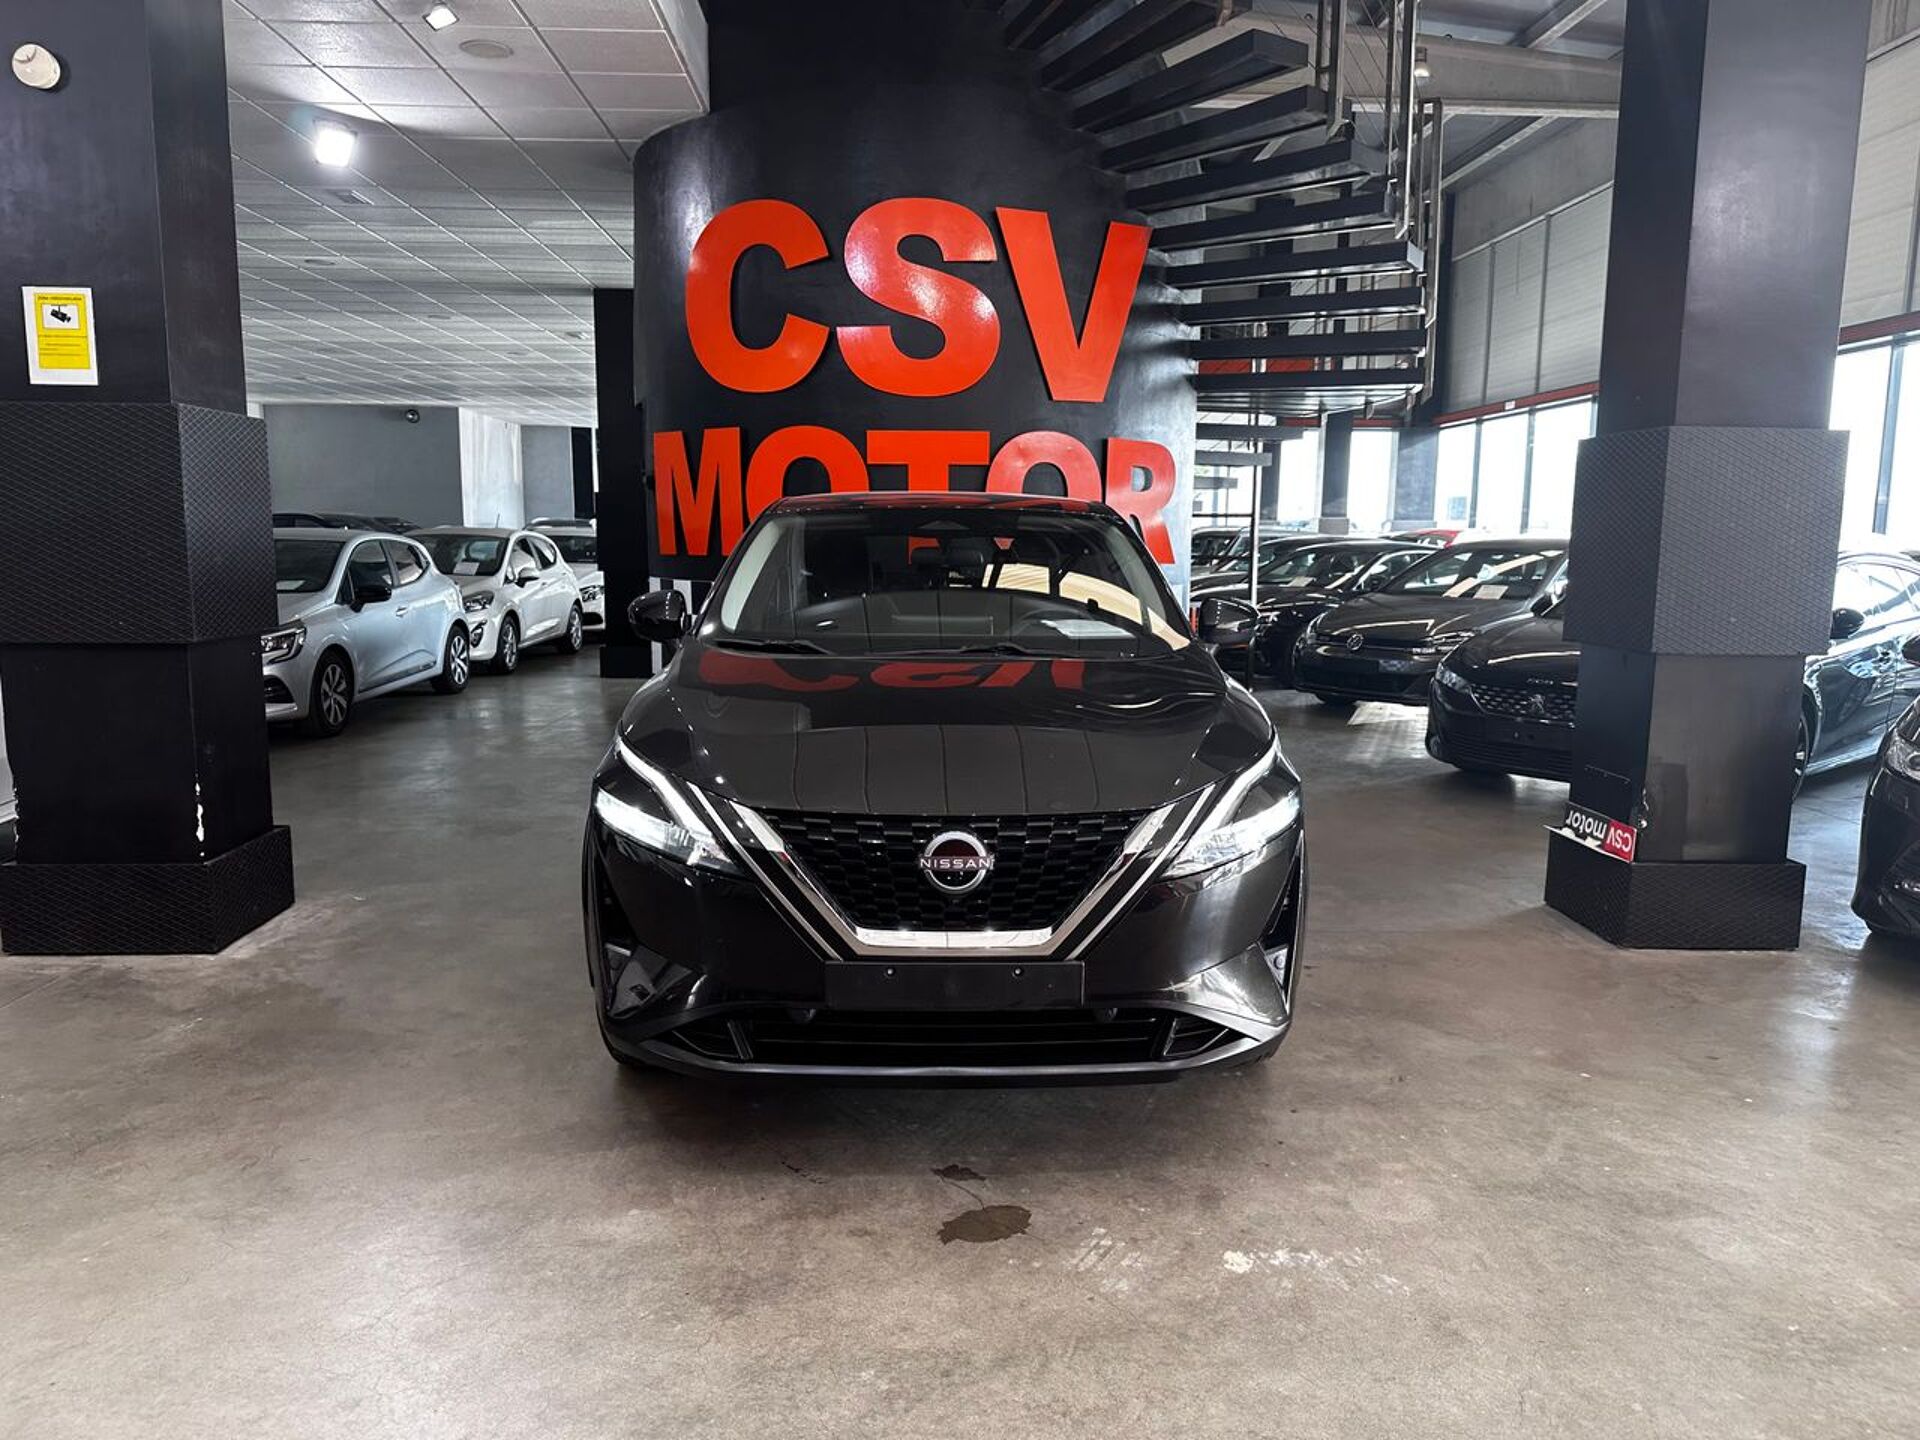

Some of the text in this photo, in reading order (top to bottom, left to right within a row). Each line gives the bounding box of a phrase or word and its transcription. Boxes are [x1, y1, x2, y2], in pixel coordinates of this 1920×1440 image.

[685, 198, 1152, 402] CSV
[1565, 810, 1633, 853] CSV motor
[920, 858, 991, 869] NISSAN
